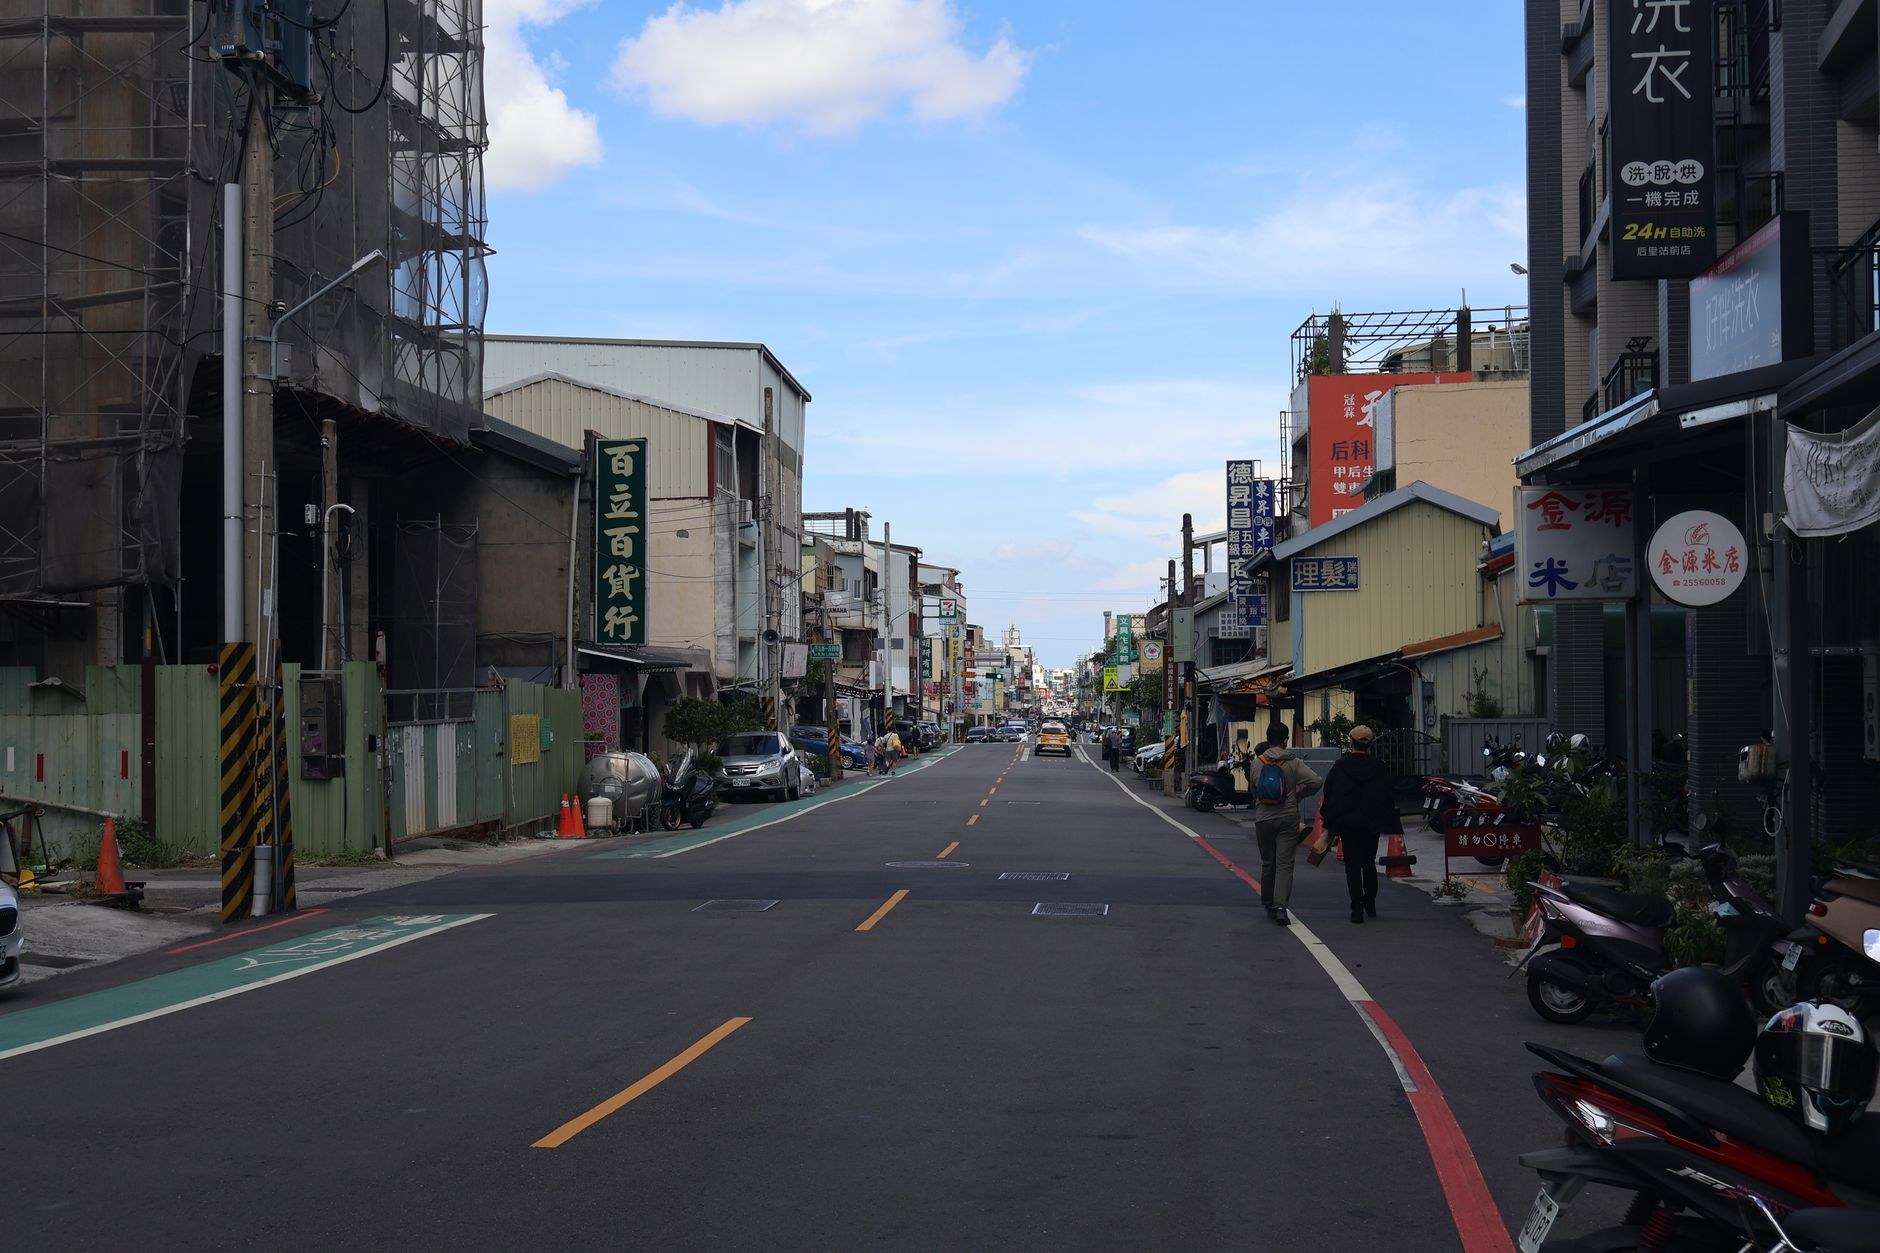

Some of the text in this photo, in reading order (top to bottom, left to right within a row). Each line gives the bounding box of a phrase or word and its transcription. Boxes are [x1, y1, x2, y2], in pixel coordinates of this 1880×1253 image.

[1626, 189, 1700, 207] 一機完成
[1622, 222, 1707, 241] 24H 自助洗
[1636, 245, 1692, 258] 后里站前店
[1331, 440, 1369, 462] 后科
[1526, 489, 1632, 531] 金源
[602, 443, 641, 641] 百立百貨行
[1294, 559, 1346, 587] 理髮
[1658, 545, 1740, 576] 金源米店
[1528, 553, 1633, 598] 米店
[1683, 578, 1727, 588] 25560058
